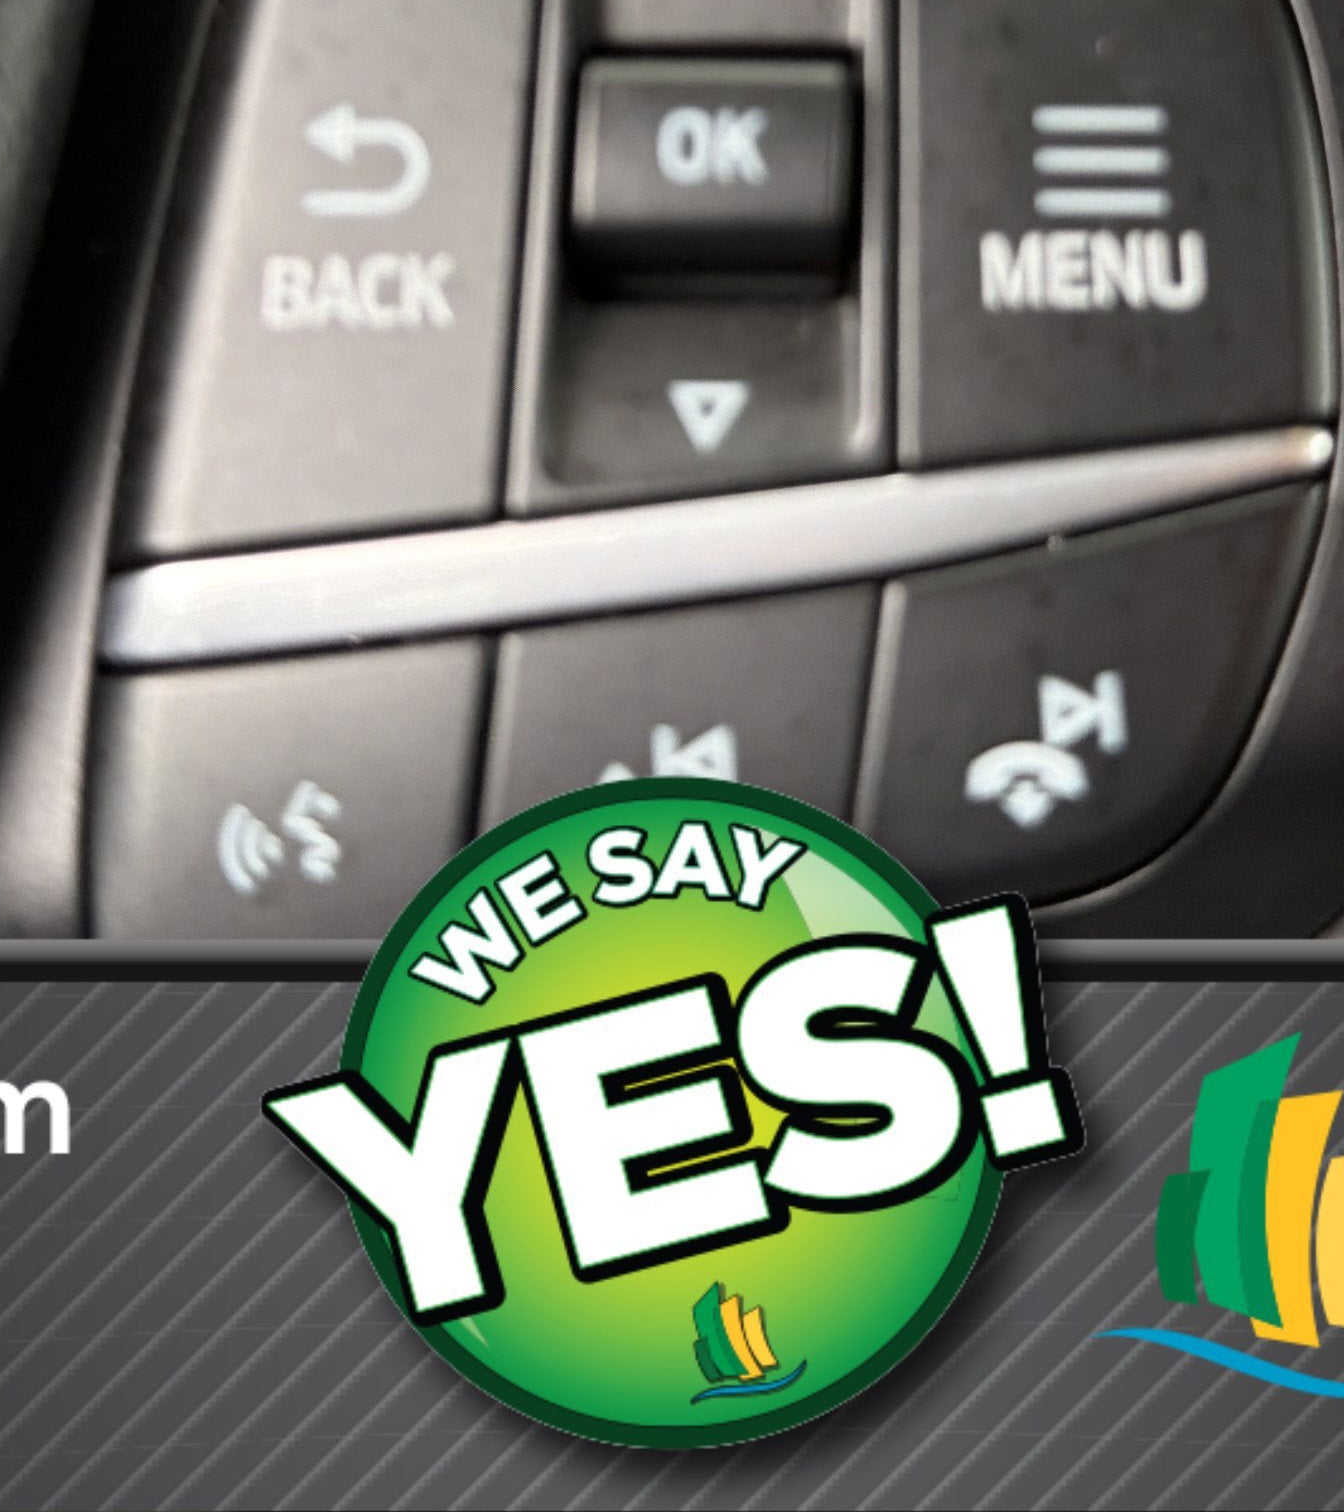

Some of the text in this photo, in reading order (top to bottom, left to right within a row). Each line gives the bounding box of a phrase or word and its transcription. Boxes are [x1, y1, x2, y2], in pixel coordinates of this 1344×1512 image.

[655, 105, 773, 187] OK
[258, 250, 457, 332] BACK
[978, 229, 1210, 314] MENU
